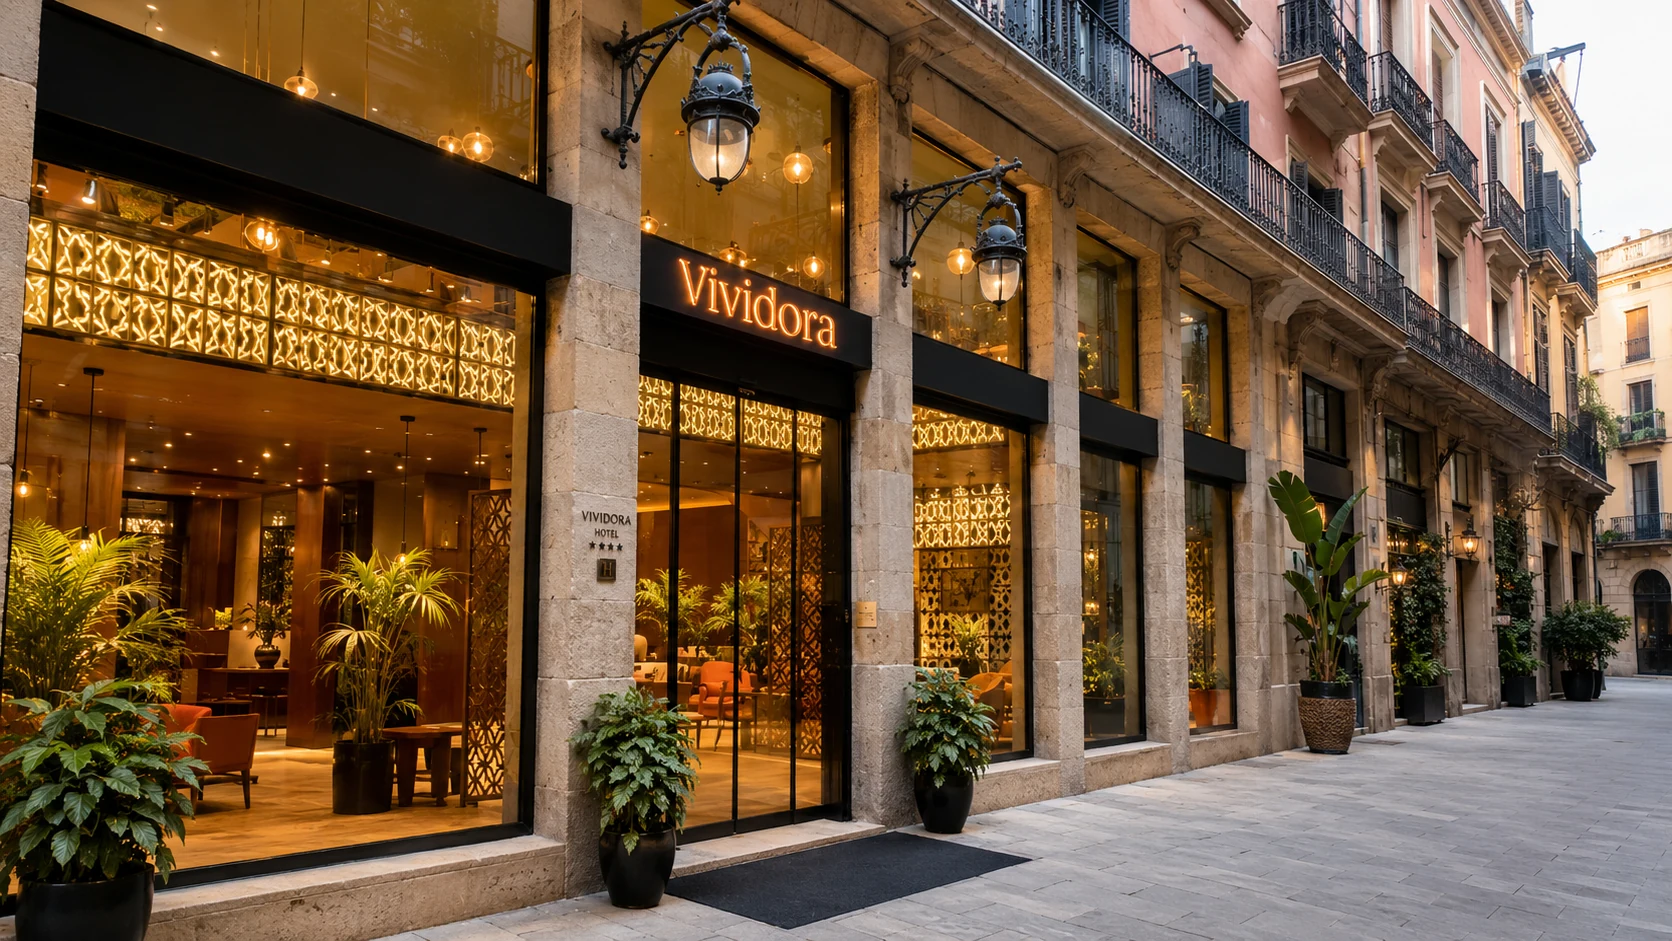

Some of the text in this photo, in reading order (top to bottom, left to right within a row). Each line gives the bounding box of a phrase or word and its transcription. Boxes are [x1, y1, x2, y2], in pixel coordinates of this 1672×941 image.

[678, 258, 837, 349] Vividora
[581, 510, 632, 526] VIVIDORA
[594, 528, 619, 539] HOTEL
[602, 561, 613, 577] H
